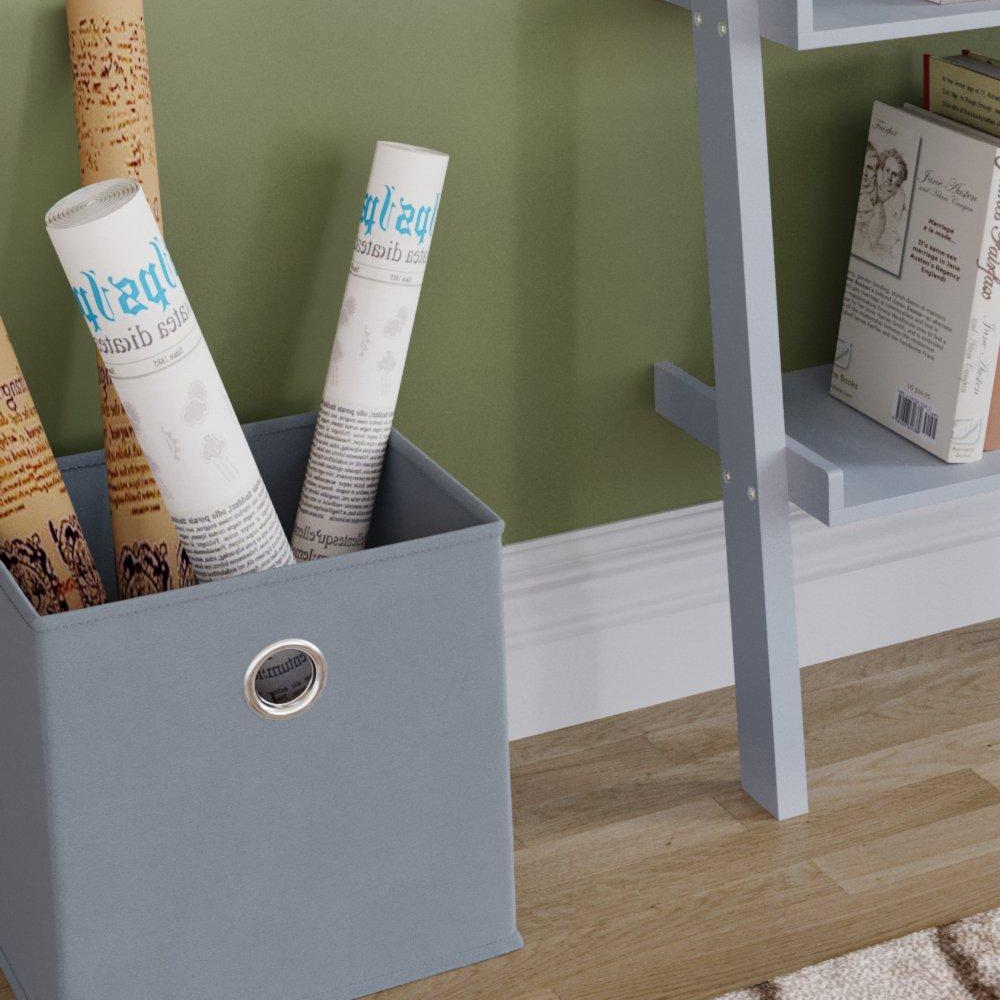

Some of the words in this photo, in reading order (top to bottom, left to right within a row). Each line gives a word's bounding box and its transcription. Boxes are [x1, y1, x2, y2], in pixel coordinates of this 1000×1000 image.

[928, 218, 954, 234] Marriage
[912, 245, 938, 262] marriage
[910, 253, 935, 269] Austen's
[936, 264, 960, 282] Regency
